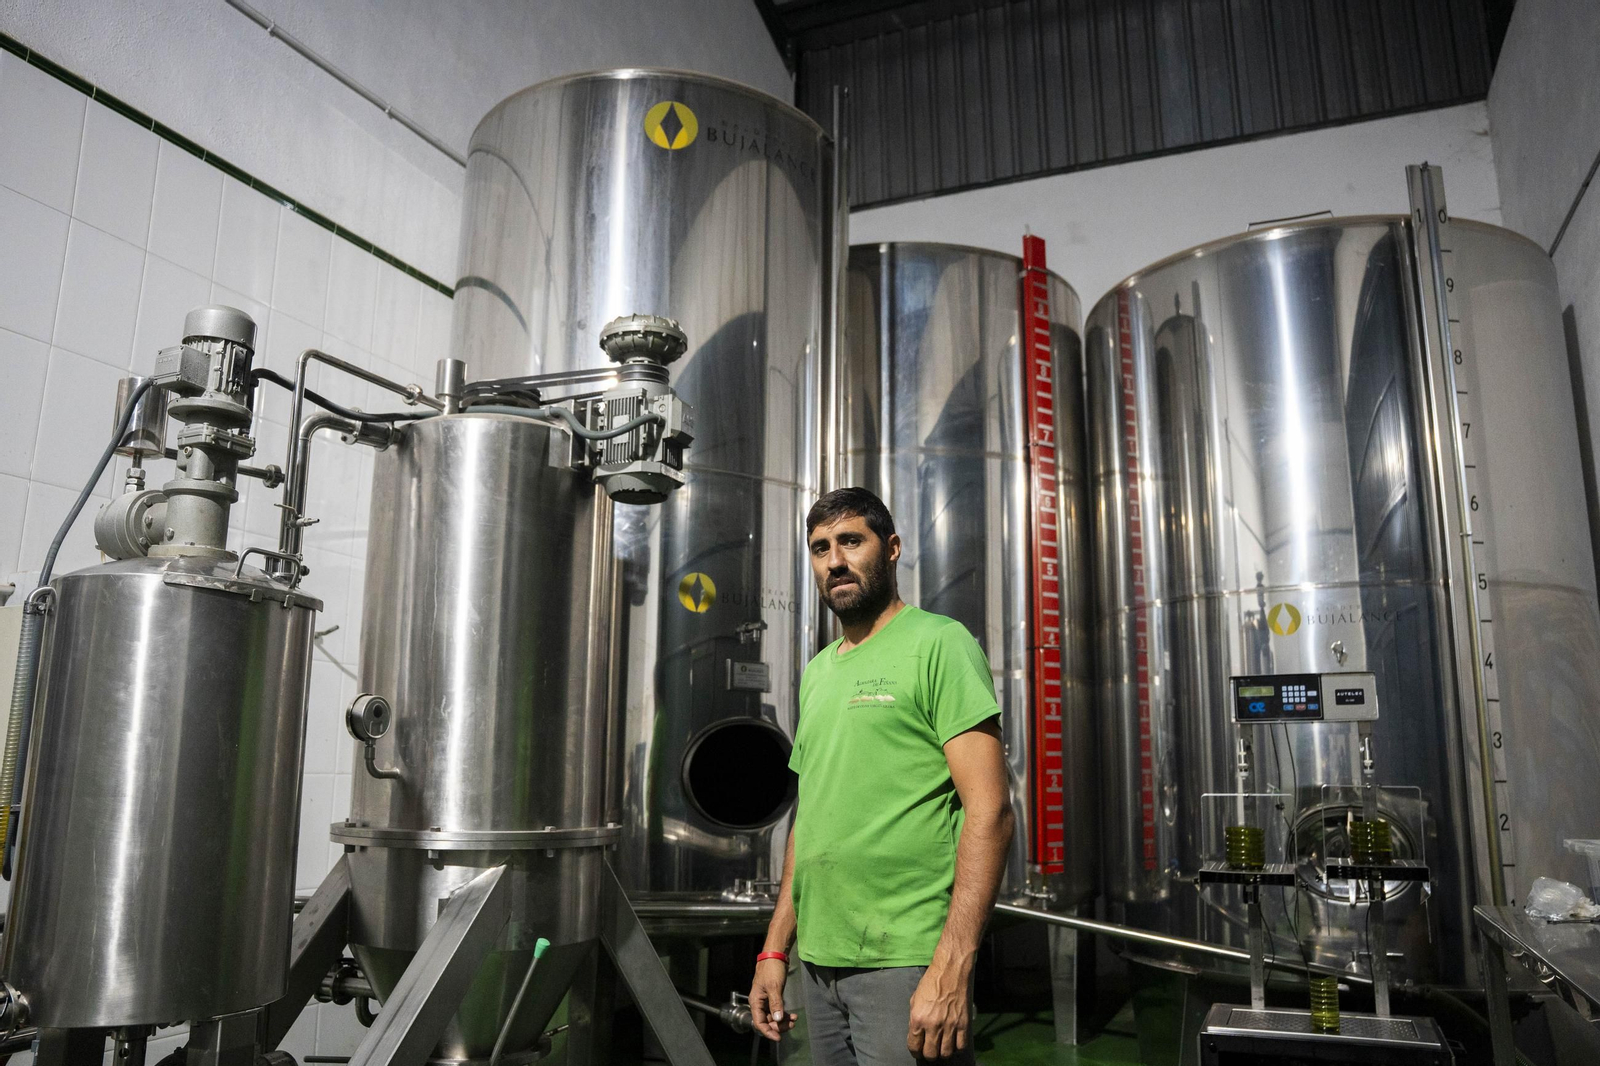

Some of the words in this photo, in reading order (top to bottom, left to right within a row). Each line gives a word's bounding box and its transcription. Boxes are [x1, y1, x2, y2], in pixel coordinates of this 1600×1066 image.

[1445, 278, 1455, 293] 9
[1454, 350, 1463, 365] 8
[1043, 430, 1051, 442] 7
[1462, 423, 1471, 438] 7
[1044, 496, 1052, 508] 6
[1470, 495, 1479, 511] 6
[1047, 563, 1054, 576] 5
[1478, 573, 1488, 590] 5
[1307, 611, 1402, 626] BUJALANCE
[1048, 632, 1056, 645] 4
[1485, 653, 1494, 670] 4
[1050, 703, 1057, 716] 3
[1493, 731, 1502, 749] 3
[1051, 775, 1058, 788] 2
[1500, 813, 1510, 831] 2
